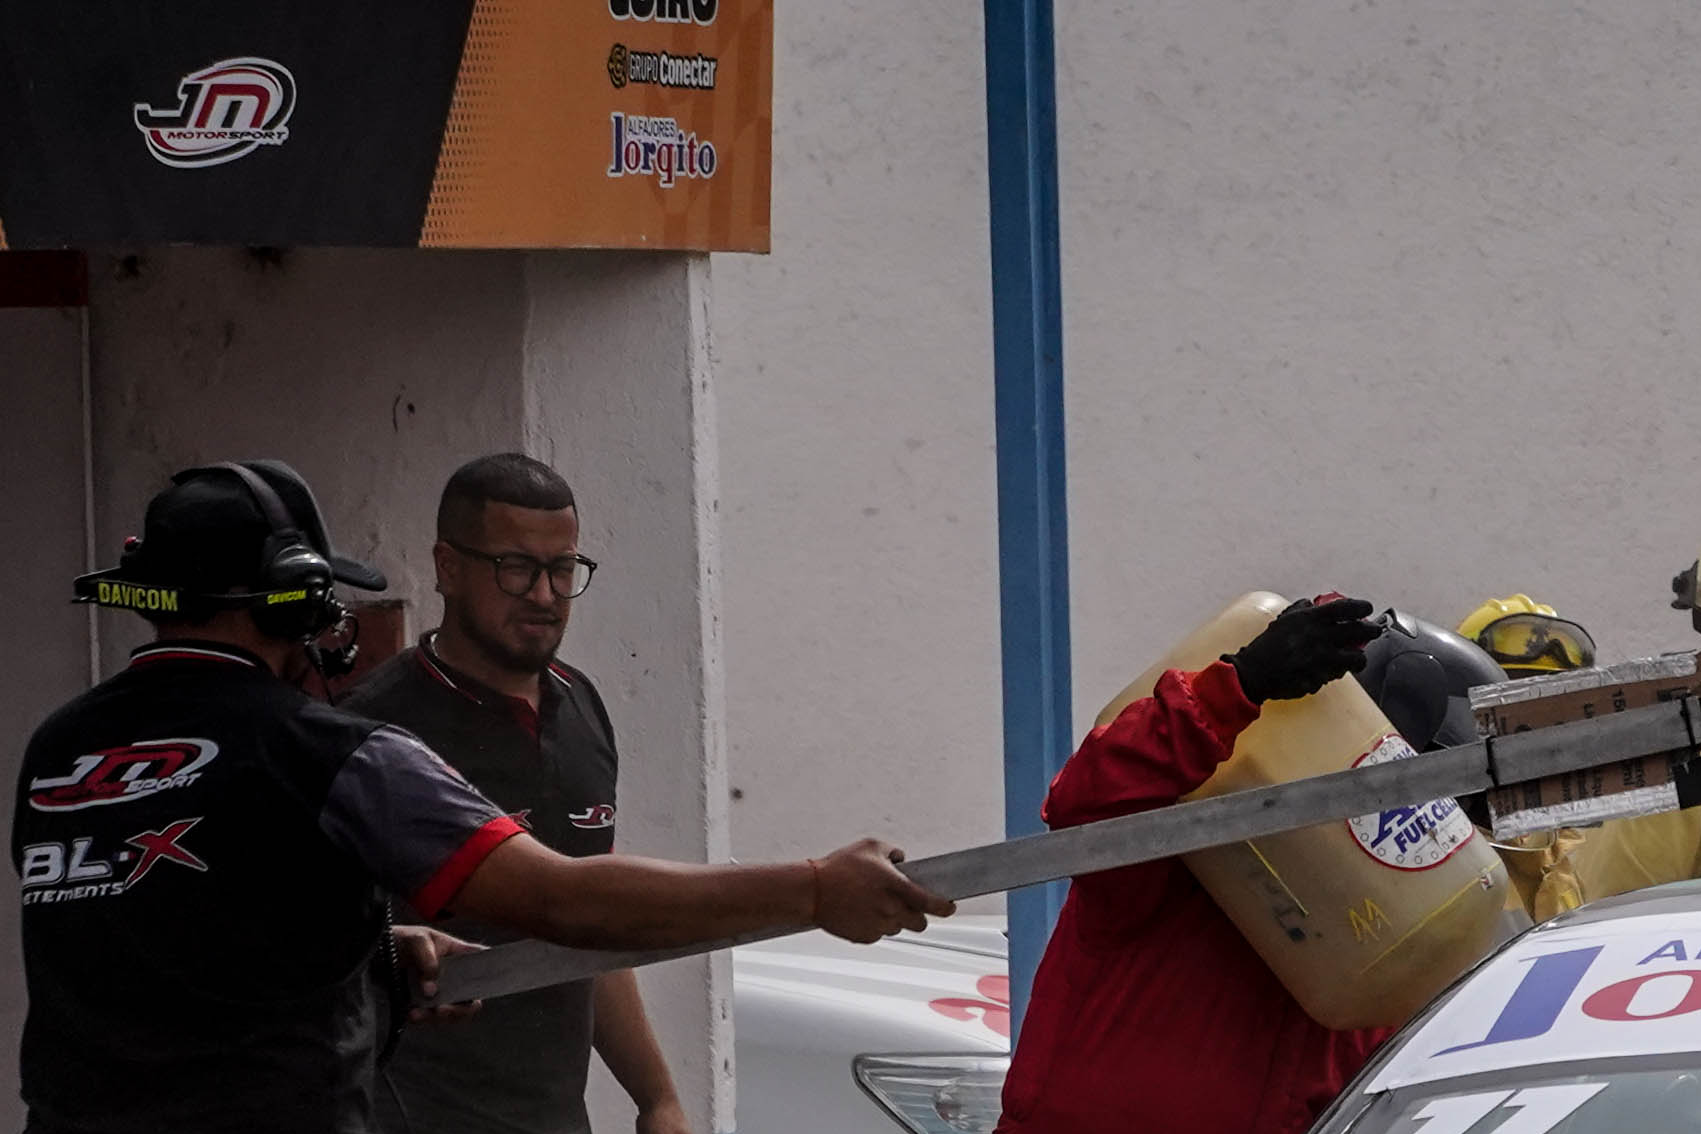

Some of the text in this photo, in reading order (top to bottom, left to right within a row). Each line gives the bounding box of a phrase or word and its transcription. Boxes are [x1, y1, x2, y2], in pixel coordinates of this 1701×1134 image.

[629, 54, 717, 87] GRUPO Conectar
[166, 130, 286, 141] MOTORSPORT
[627, 118, 676, 138] ALFAJORES
[609, 113, 717, 187] Jorgito
[97, 582, 179, 611] DAVICOM
[1393, 813, 1437, 855] FUEL
